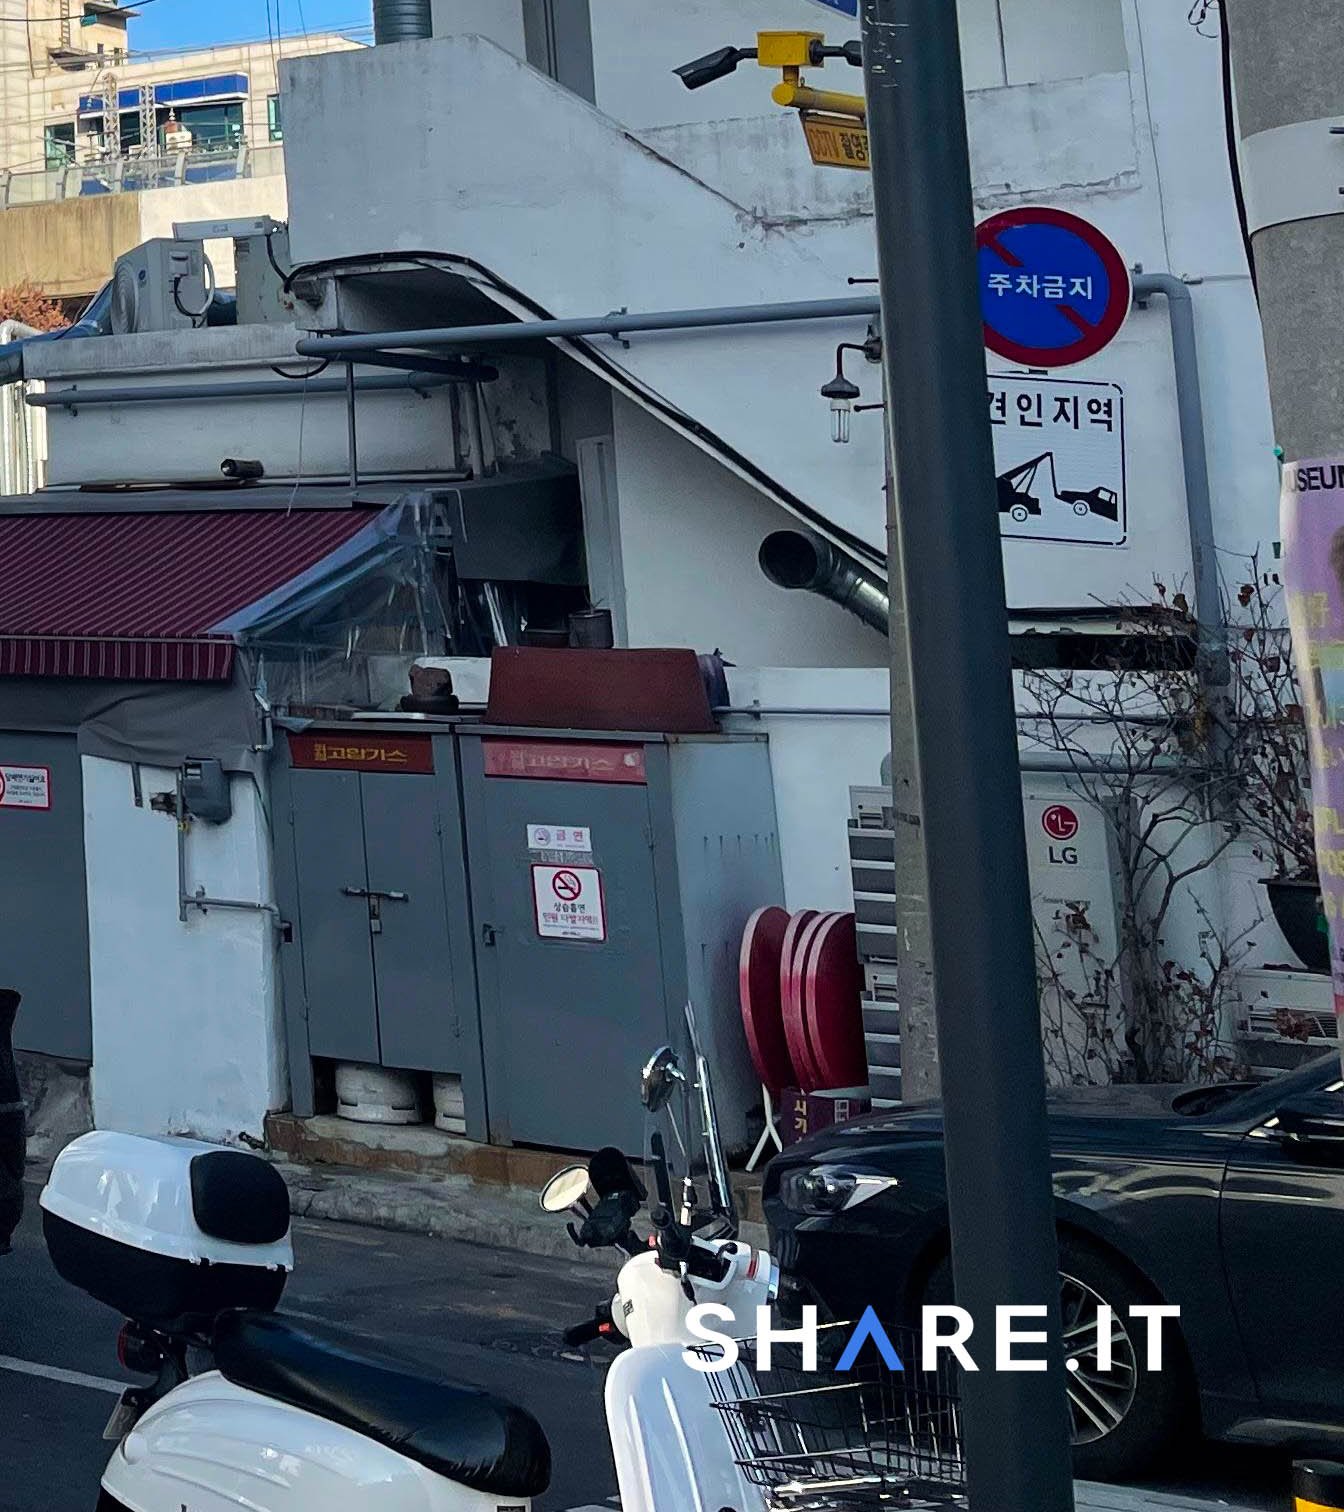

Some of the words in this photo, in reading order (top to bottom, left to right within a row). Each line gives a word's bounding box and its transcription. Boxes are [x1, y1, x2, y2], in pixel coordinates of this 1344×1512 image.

[987, 273, 1093, 300] 주차금지
[985, 391, 1114, 432] 견인지역
[1048, 846, 1078, 865] LG
